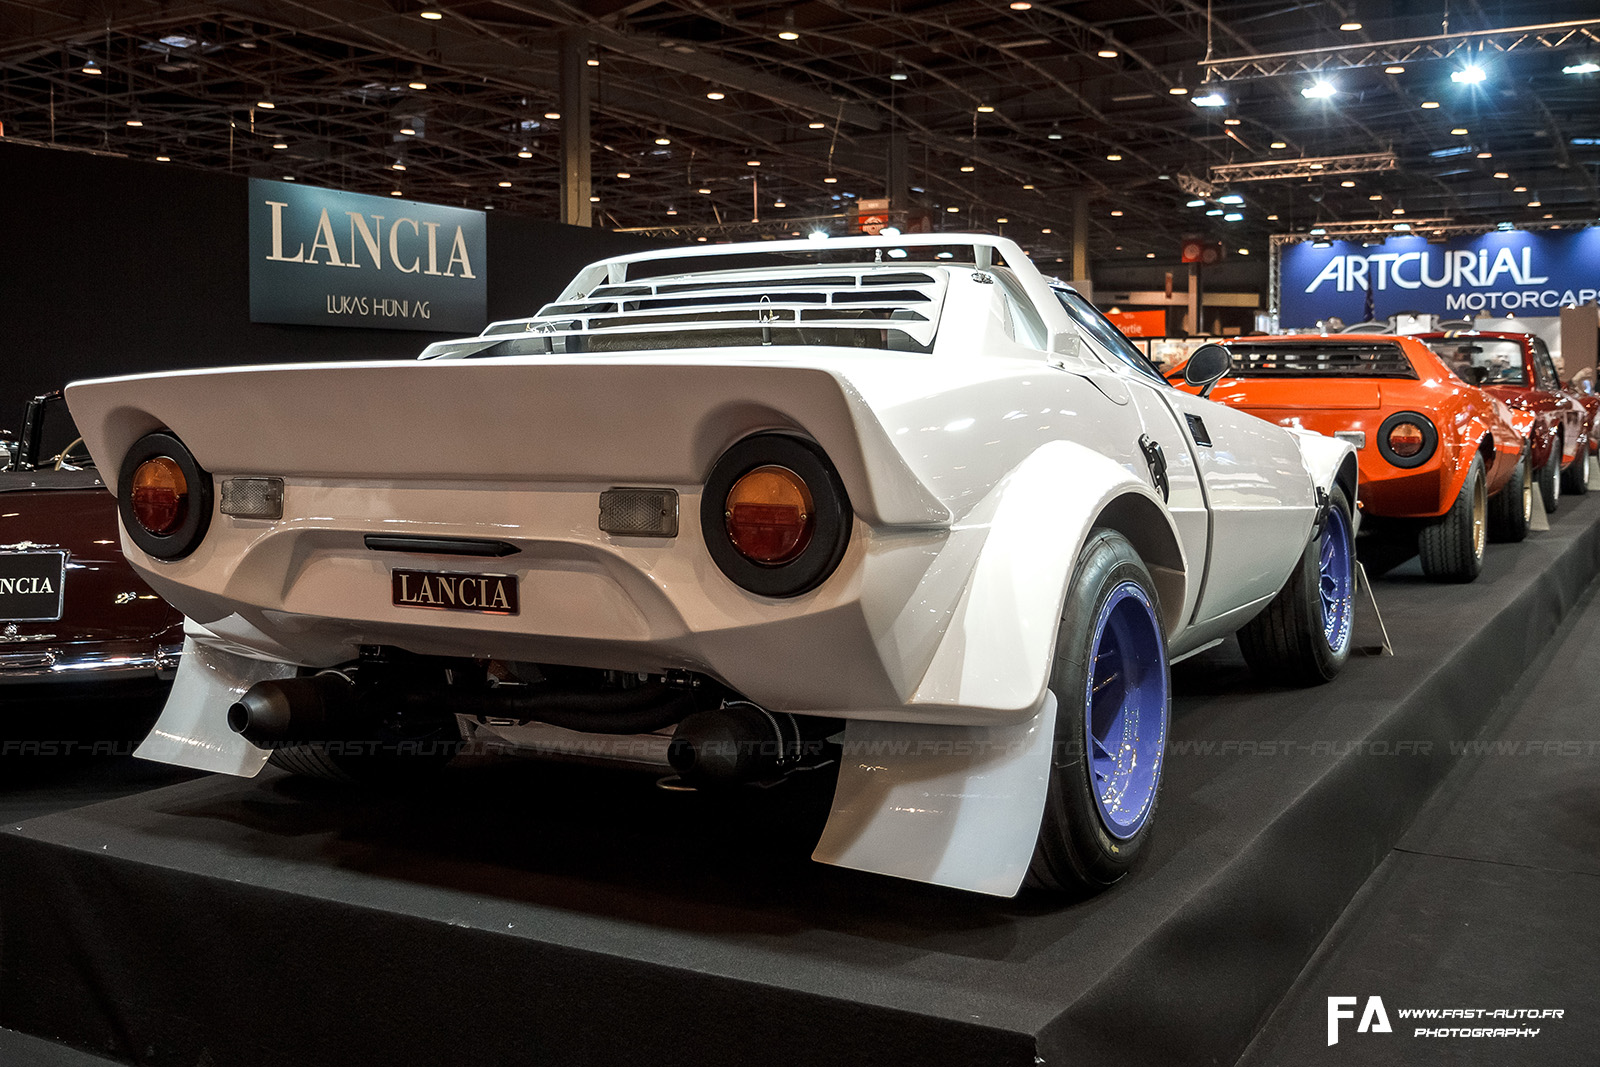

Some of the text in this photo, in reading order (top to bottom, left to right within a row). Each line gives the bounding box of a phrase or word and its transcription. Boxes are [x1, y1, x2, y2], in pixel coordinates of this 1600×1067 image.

[265, 201, 476, 279] LANCIA
[327, 294, 369, 316] LUKAS
[412, 300, 431, 319] AG
[1446, 288, 1600, 311] MOTORCAR
[399, 574, 511, 609] LANCIA
